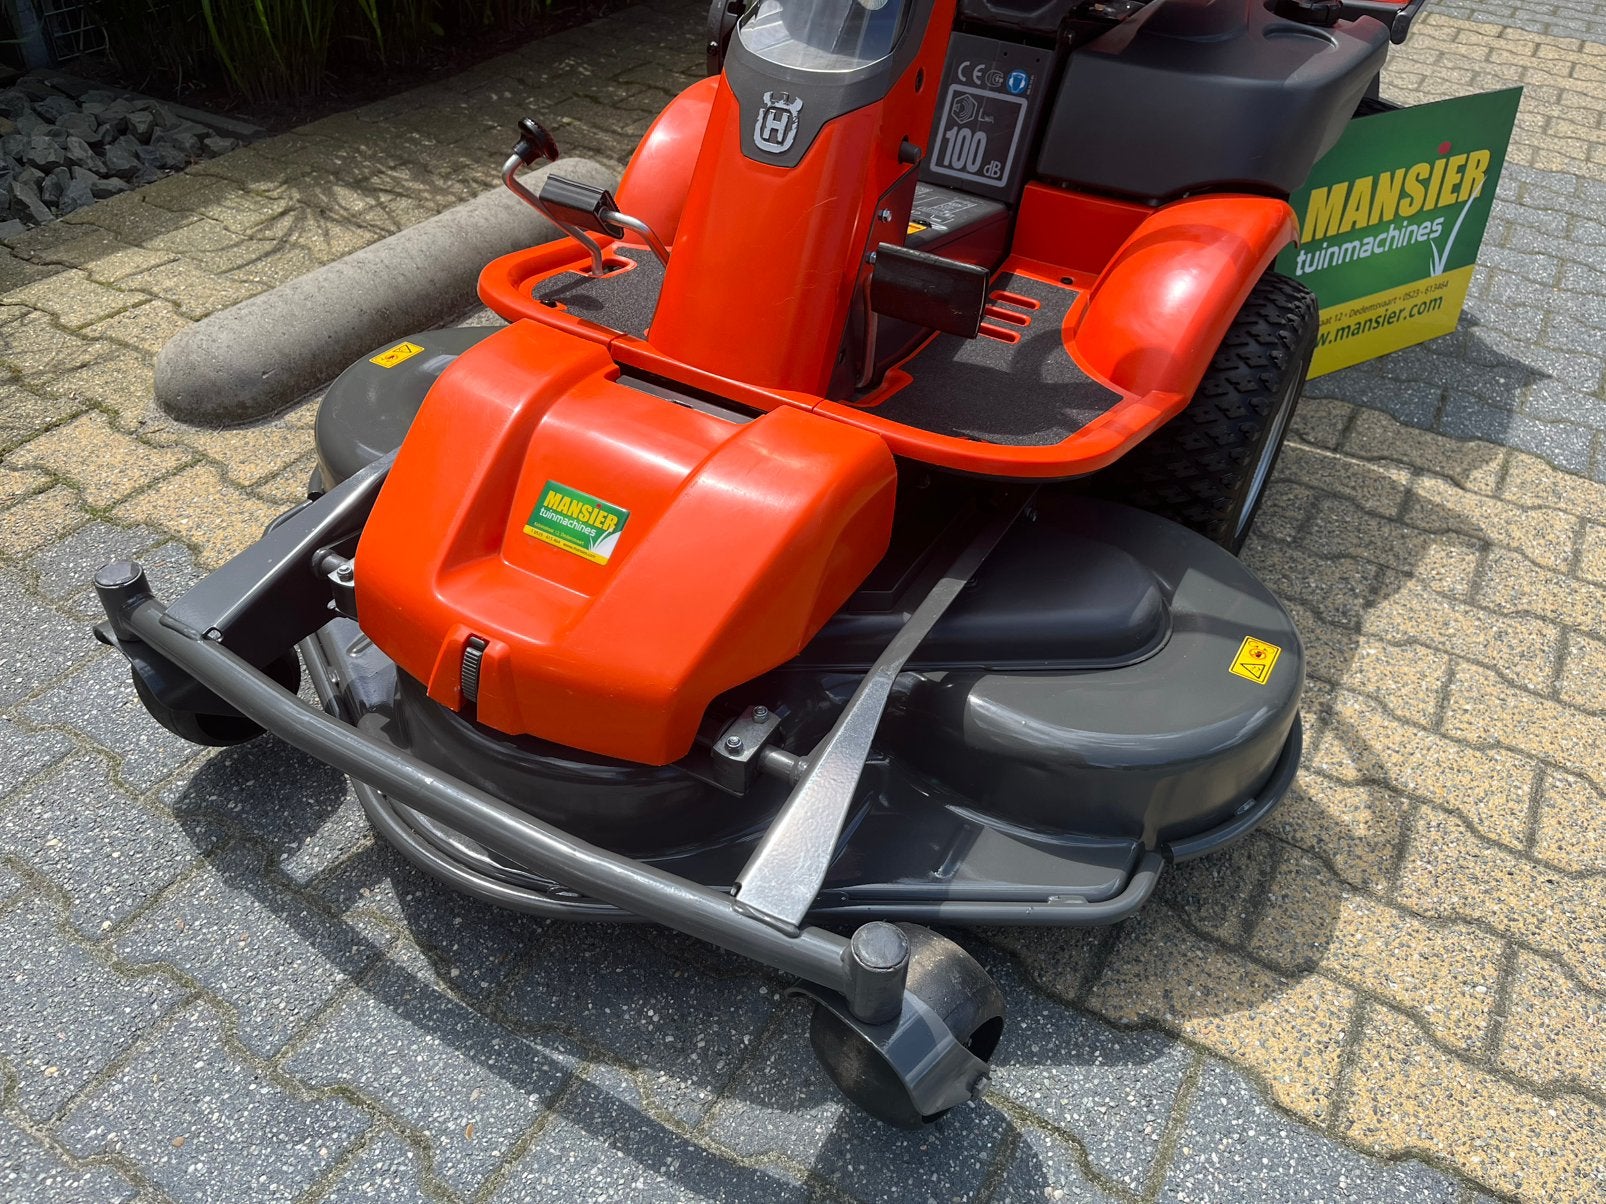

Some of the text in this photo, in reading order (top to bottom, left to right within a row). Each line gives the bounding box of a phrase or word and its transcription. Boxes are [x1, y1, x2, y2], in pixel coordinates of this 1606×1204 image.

[944, 126, 1002, 178] 100 dB
[1301, 142, 1490, 244] MANSIER
[1295, 217, 1445, 276] tuinmachines
[539, 506, 597, 537] tuinmachines
[543, 490, 618, 533] MANSIER
